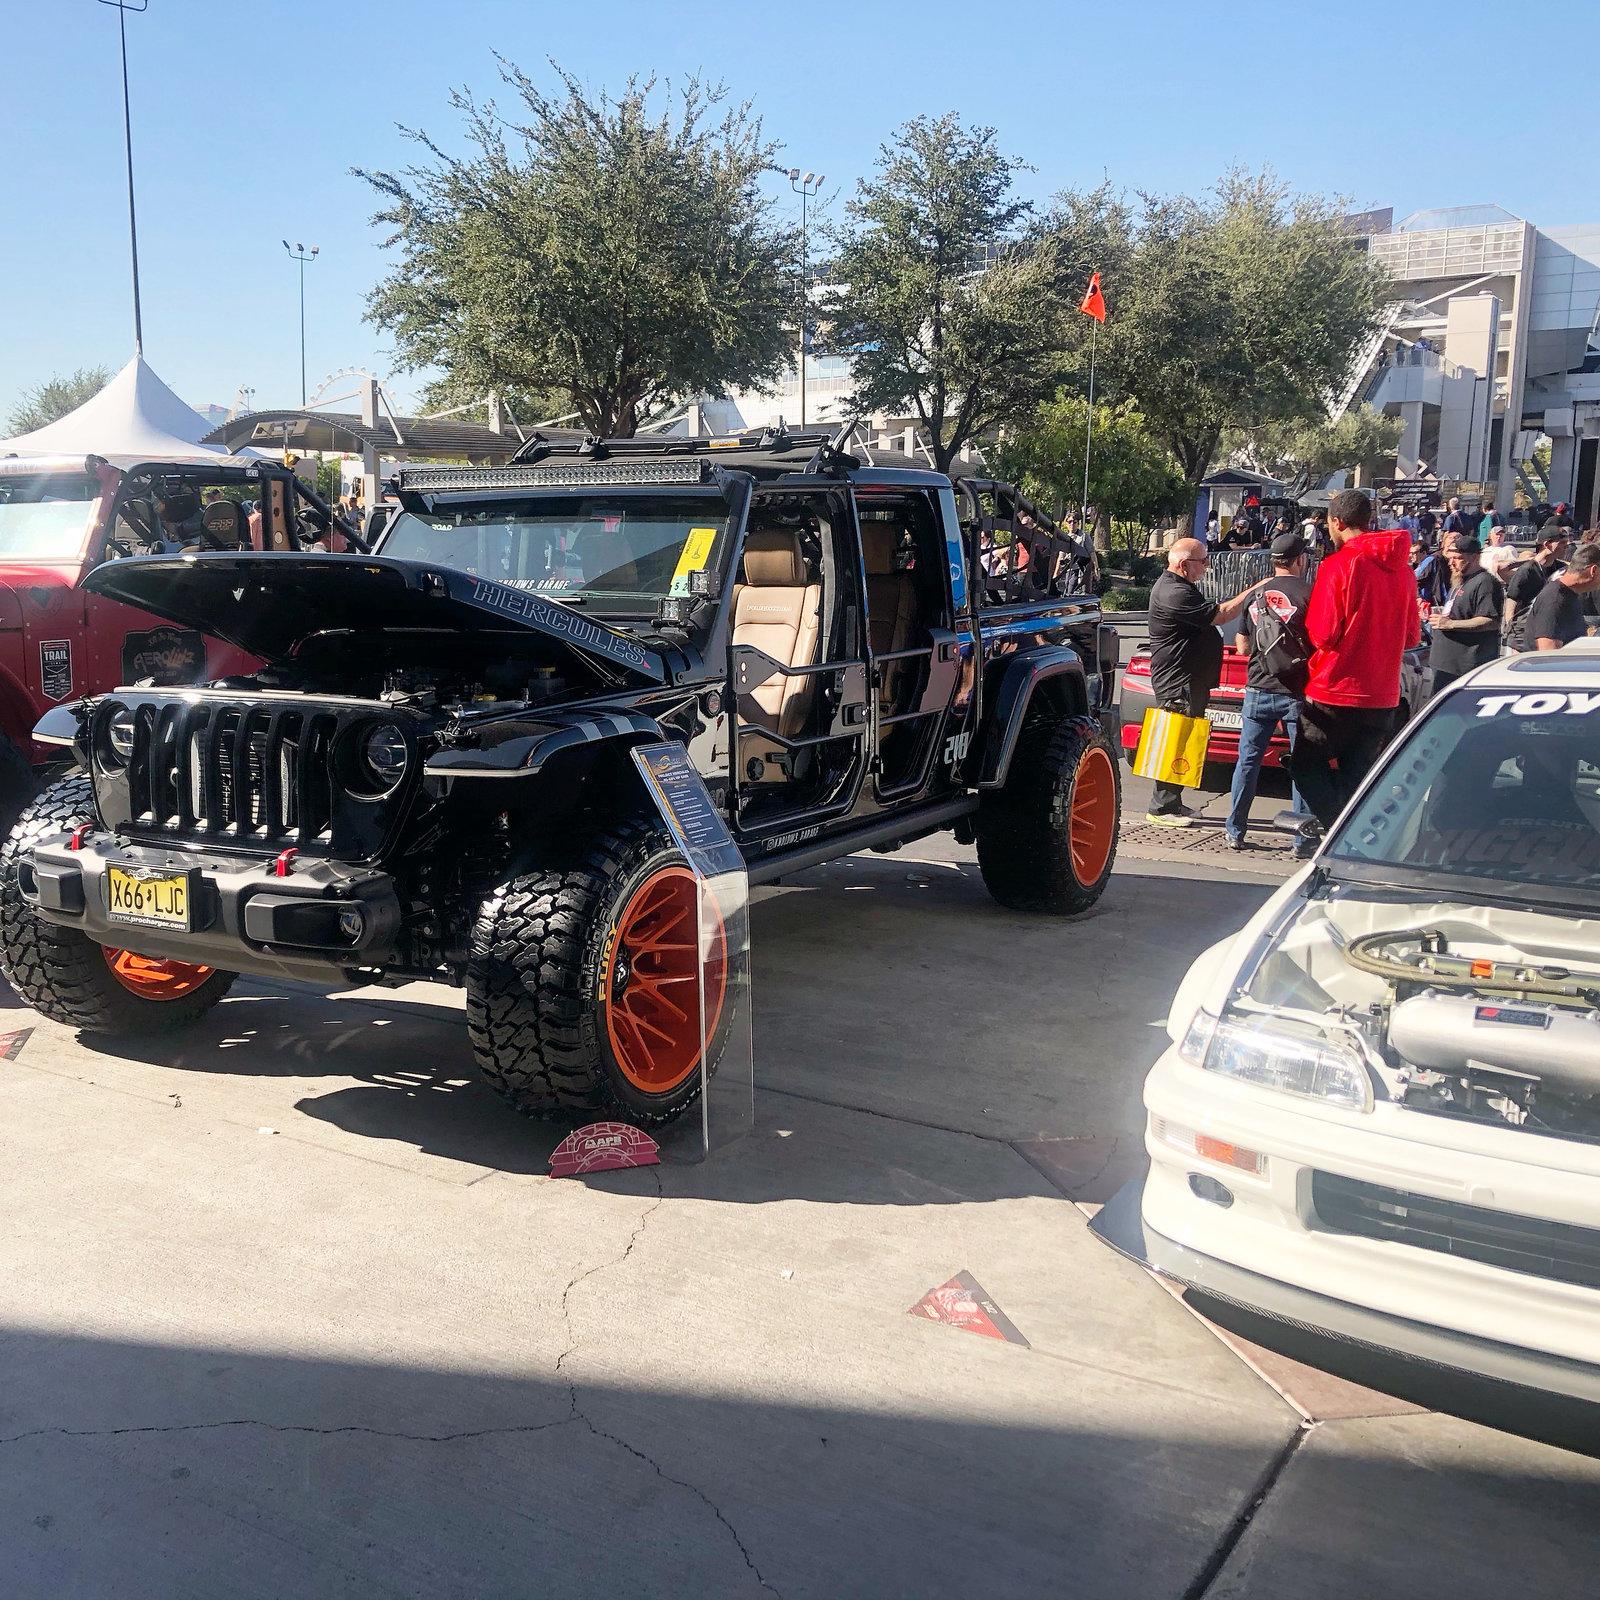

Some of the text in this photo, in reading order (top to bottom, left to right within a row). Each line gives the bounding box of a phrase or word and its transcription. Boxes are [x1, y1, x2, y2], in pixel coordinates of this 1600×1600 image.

[473, 581, 647, 666] HERCULES
[44, 650, 68, 661] TRAIL
[113, 879, 184, 916] X66 LJC
[598, 919, 618, 1002] FURY
